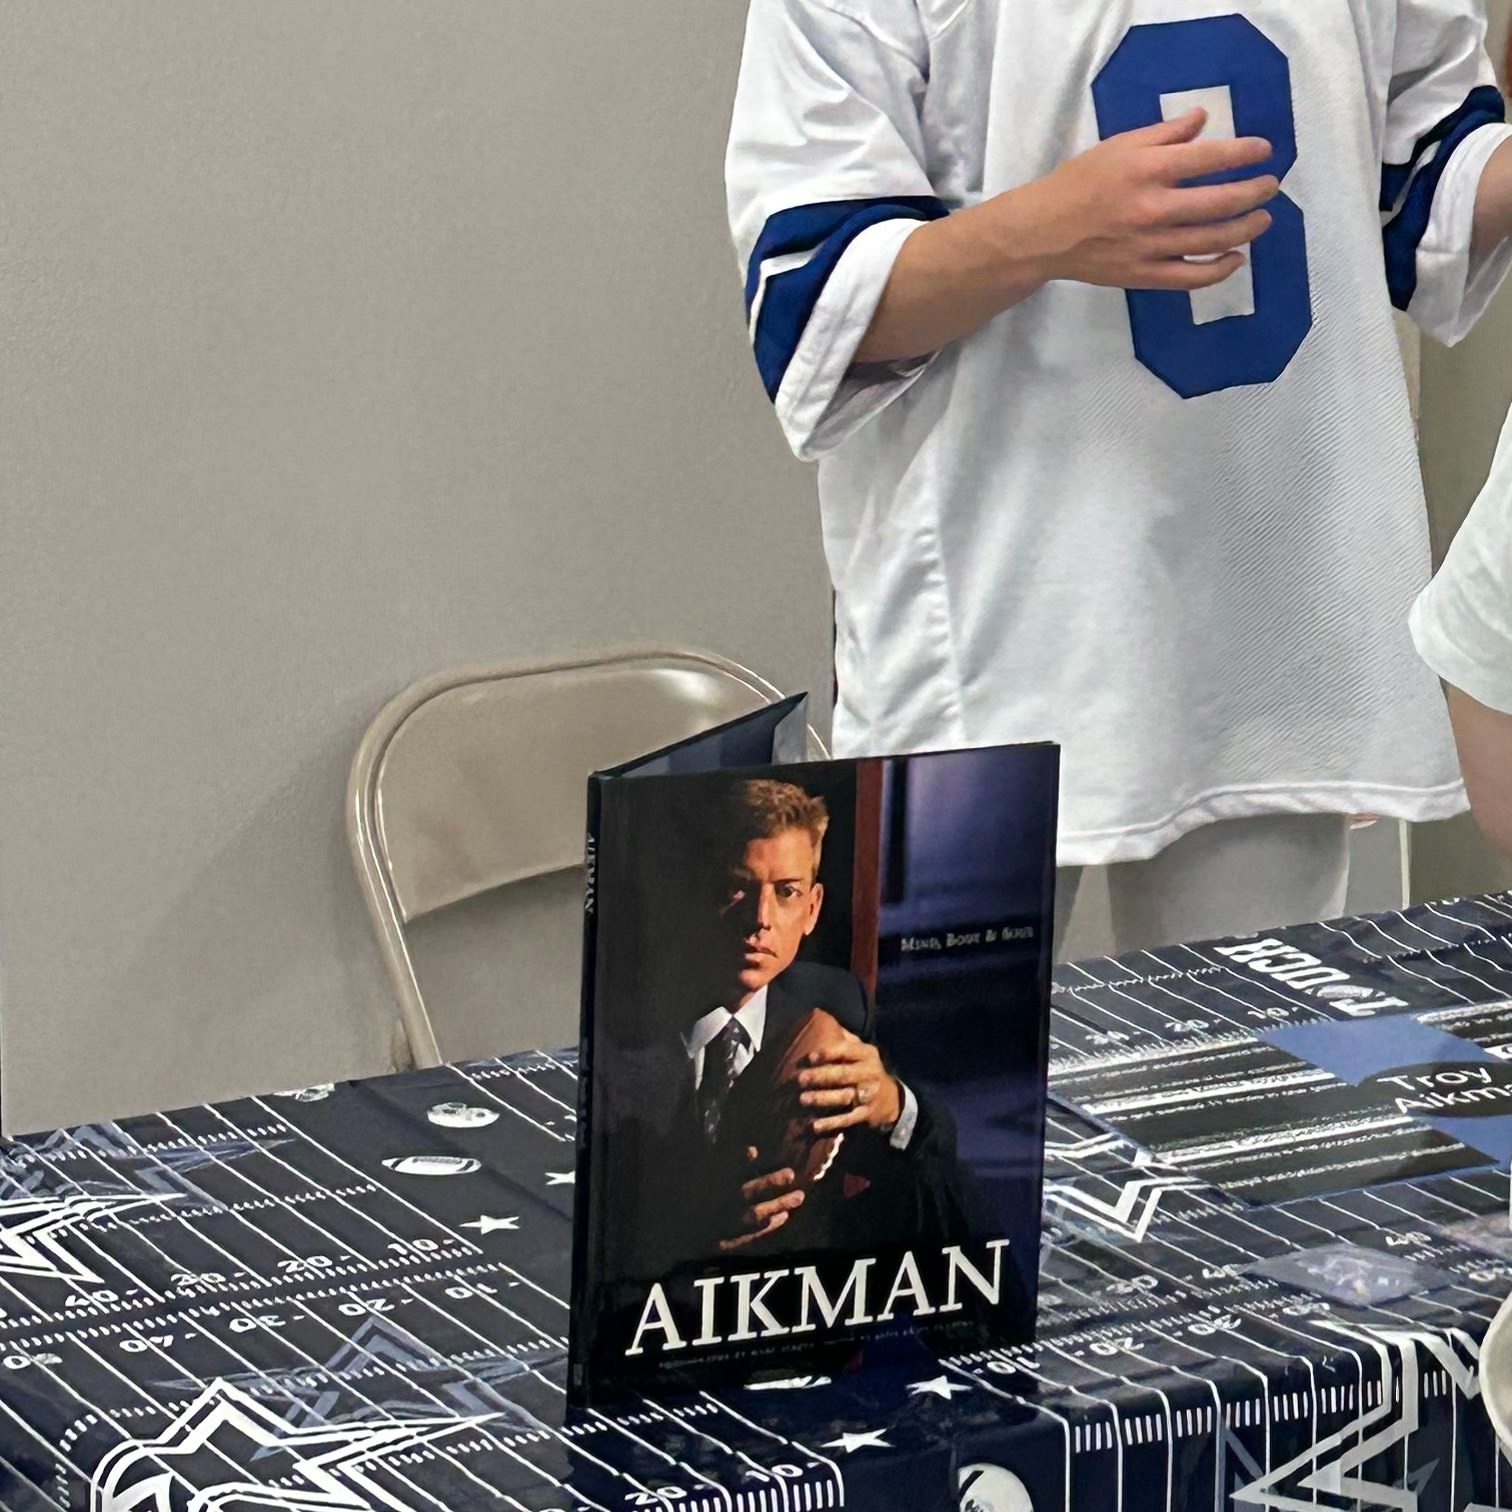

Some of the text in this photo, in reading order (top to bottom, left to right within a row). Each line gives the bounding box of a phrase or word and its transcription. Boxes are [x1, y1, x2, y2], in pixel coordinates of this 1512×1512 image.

[1090, 13, 1314, 399] 8
[1376, 1067, 1493, 1092] Troy
[387, 1238, 439, 1256] 10
[276, 1254, 333, 1274] 20
[624, 1238, 1011, 1357] AIKMAN
[744, 1463, 804, 1483] 10
[624, 1485, 688, 1506] 20
